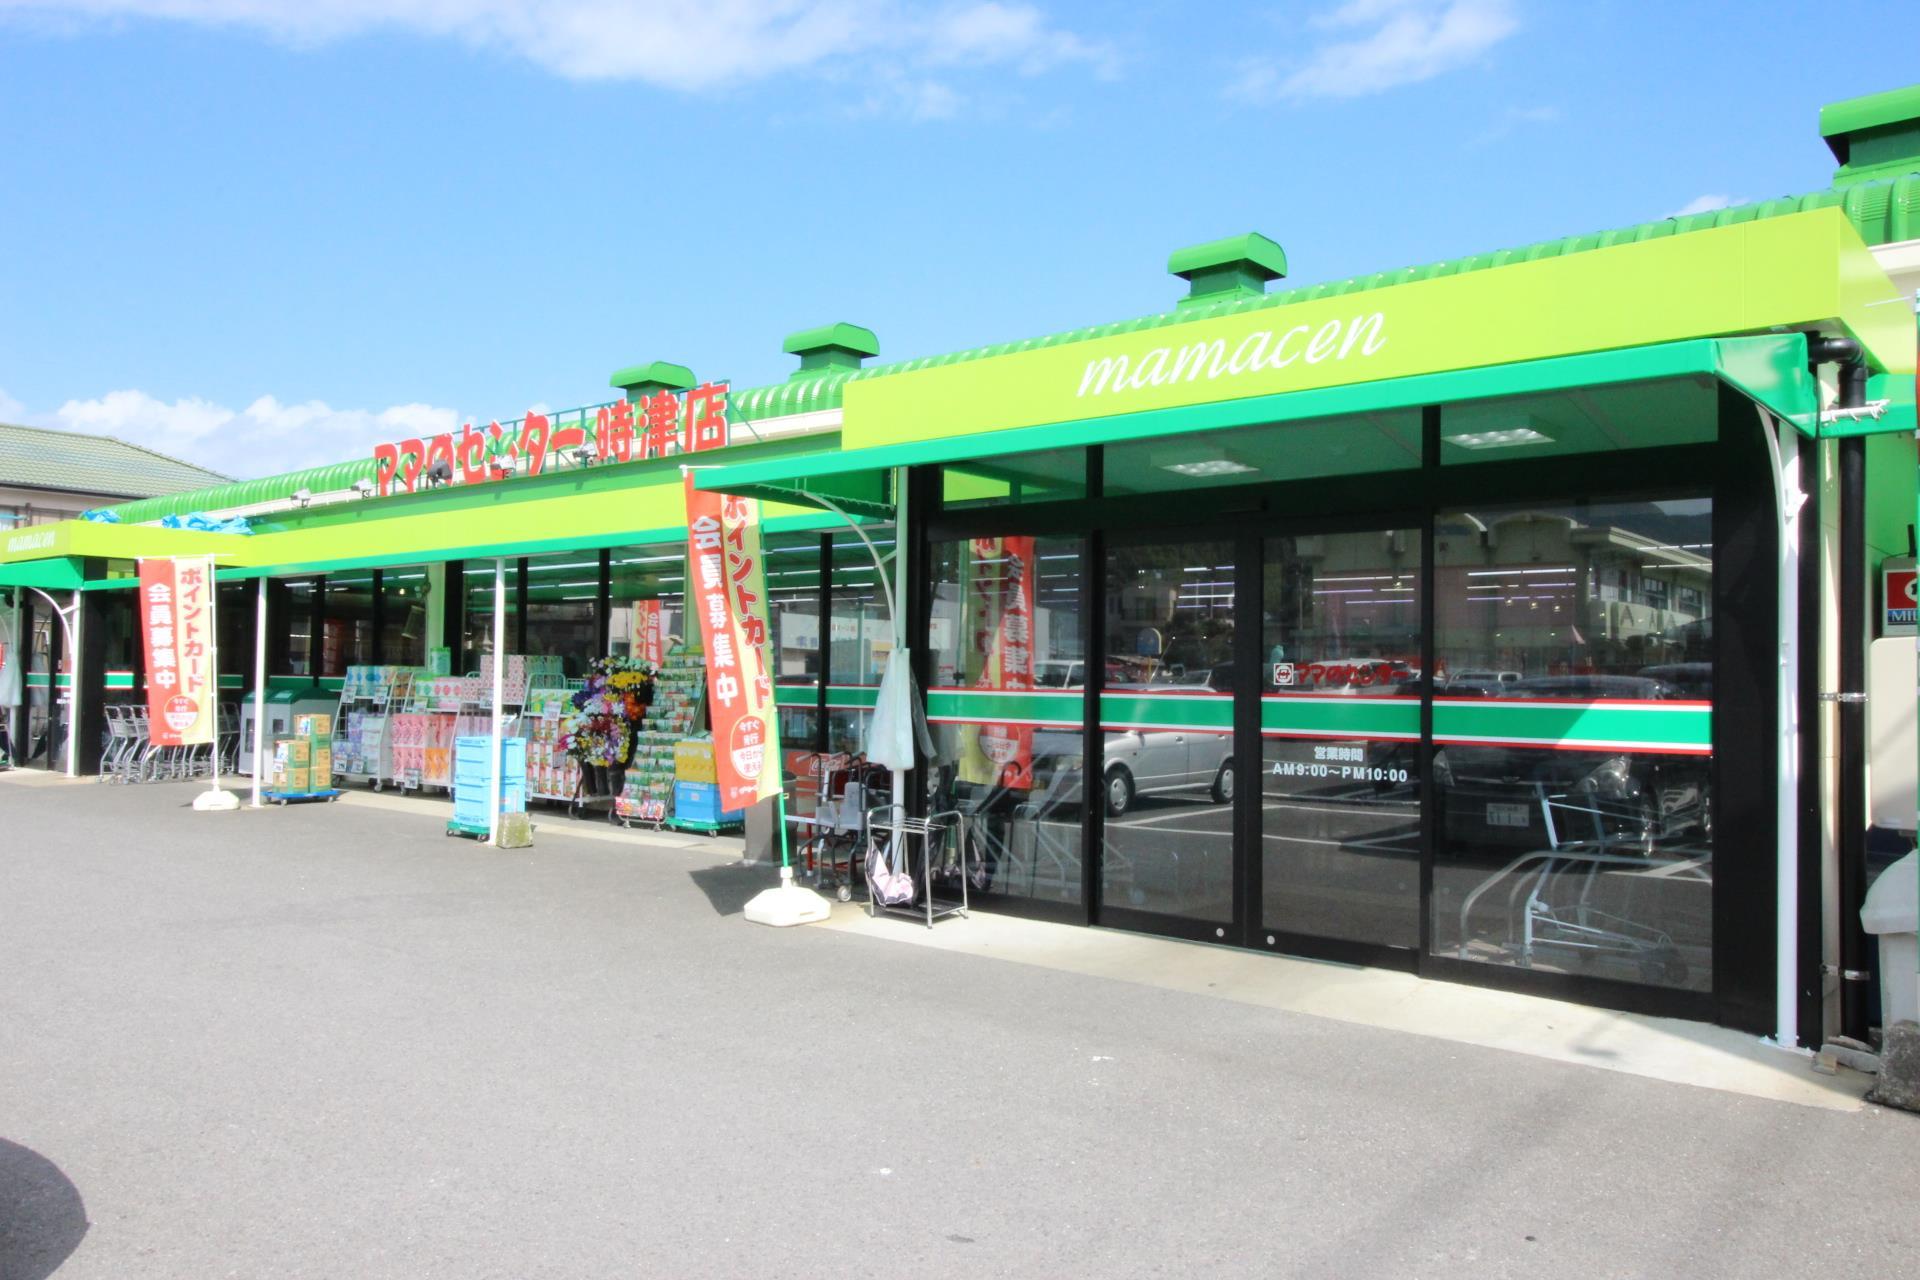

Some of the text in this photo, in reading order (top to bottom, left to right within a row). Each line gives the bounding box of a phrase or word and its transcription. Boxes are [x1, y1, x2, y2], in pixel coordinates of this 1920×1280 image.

[1077, 312, 1387, 398] mamacen
[147, 582, 177, 689] 会員募集中
[180, 566, 206, 694] ポイントカード
[691, 514, 739, 708] 会員募集中
[1295, 663, 1409, 685] ママのセンター
[1314, 746, 1363, 762] 営業時間
